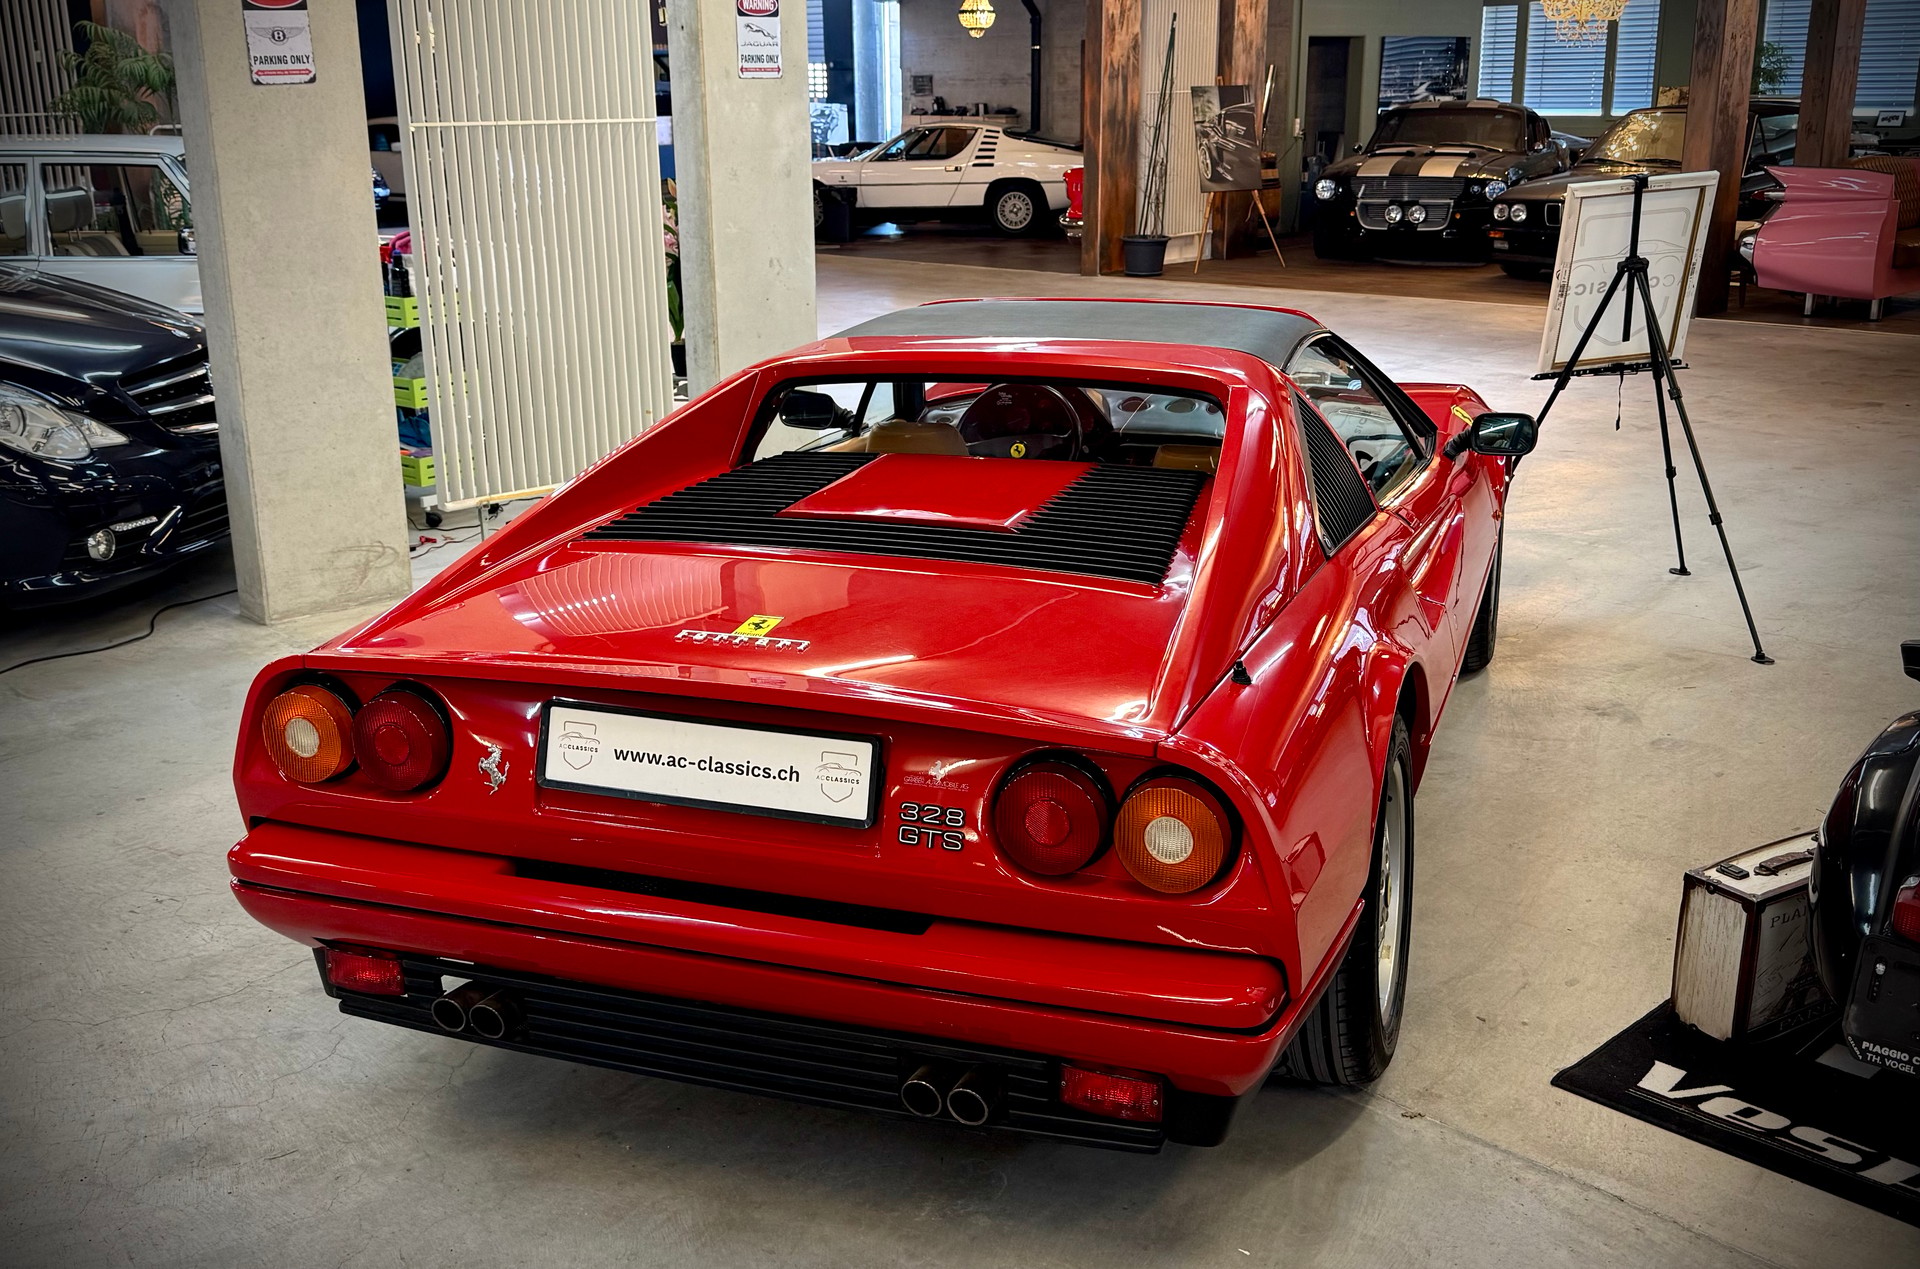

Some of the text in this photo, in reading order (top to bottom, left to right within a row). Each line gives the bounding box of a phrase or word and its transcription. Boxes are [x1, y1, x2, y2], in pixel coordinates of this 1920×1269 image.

[743, 0, 774, 10] WARNING
[253, 54, 310, 65] PARKING ONLY
[741, 54, 779, 63] PARKING ONLY
[614, 748, 800, 783] www.ac-classics.ch
[900, 802, 965, 827] 328
[899, 825, 964, 851] GTS
[1861, 1041, 1909, 1061] PIAGGIO
[1866, 1053, 1916, 1075] TH. VOGEL
